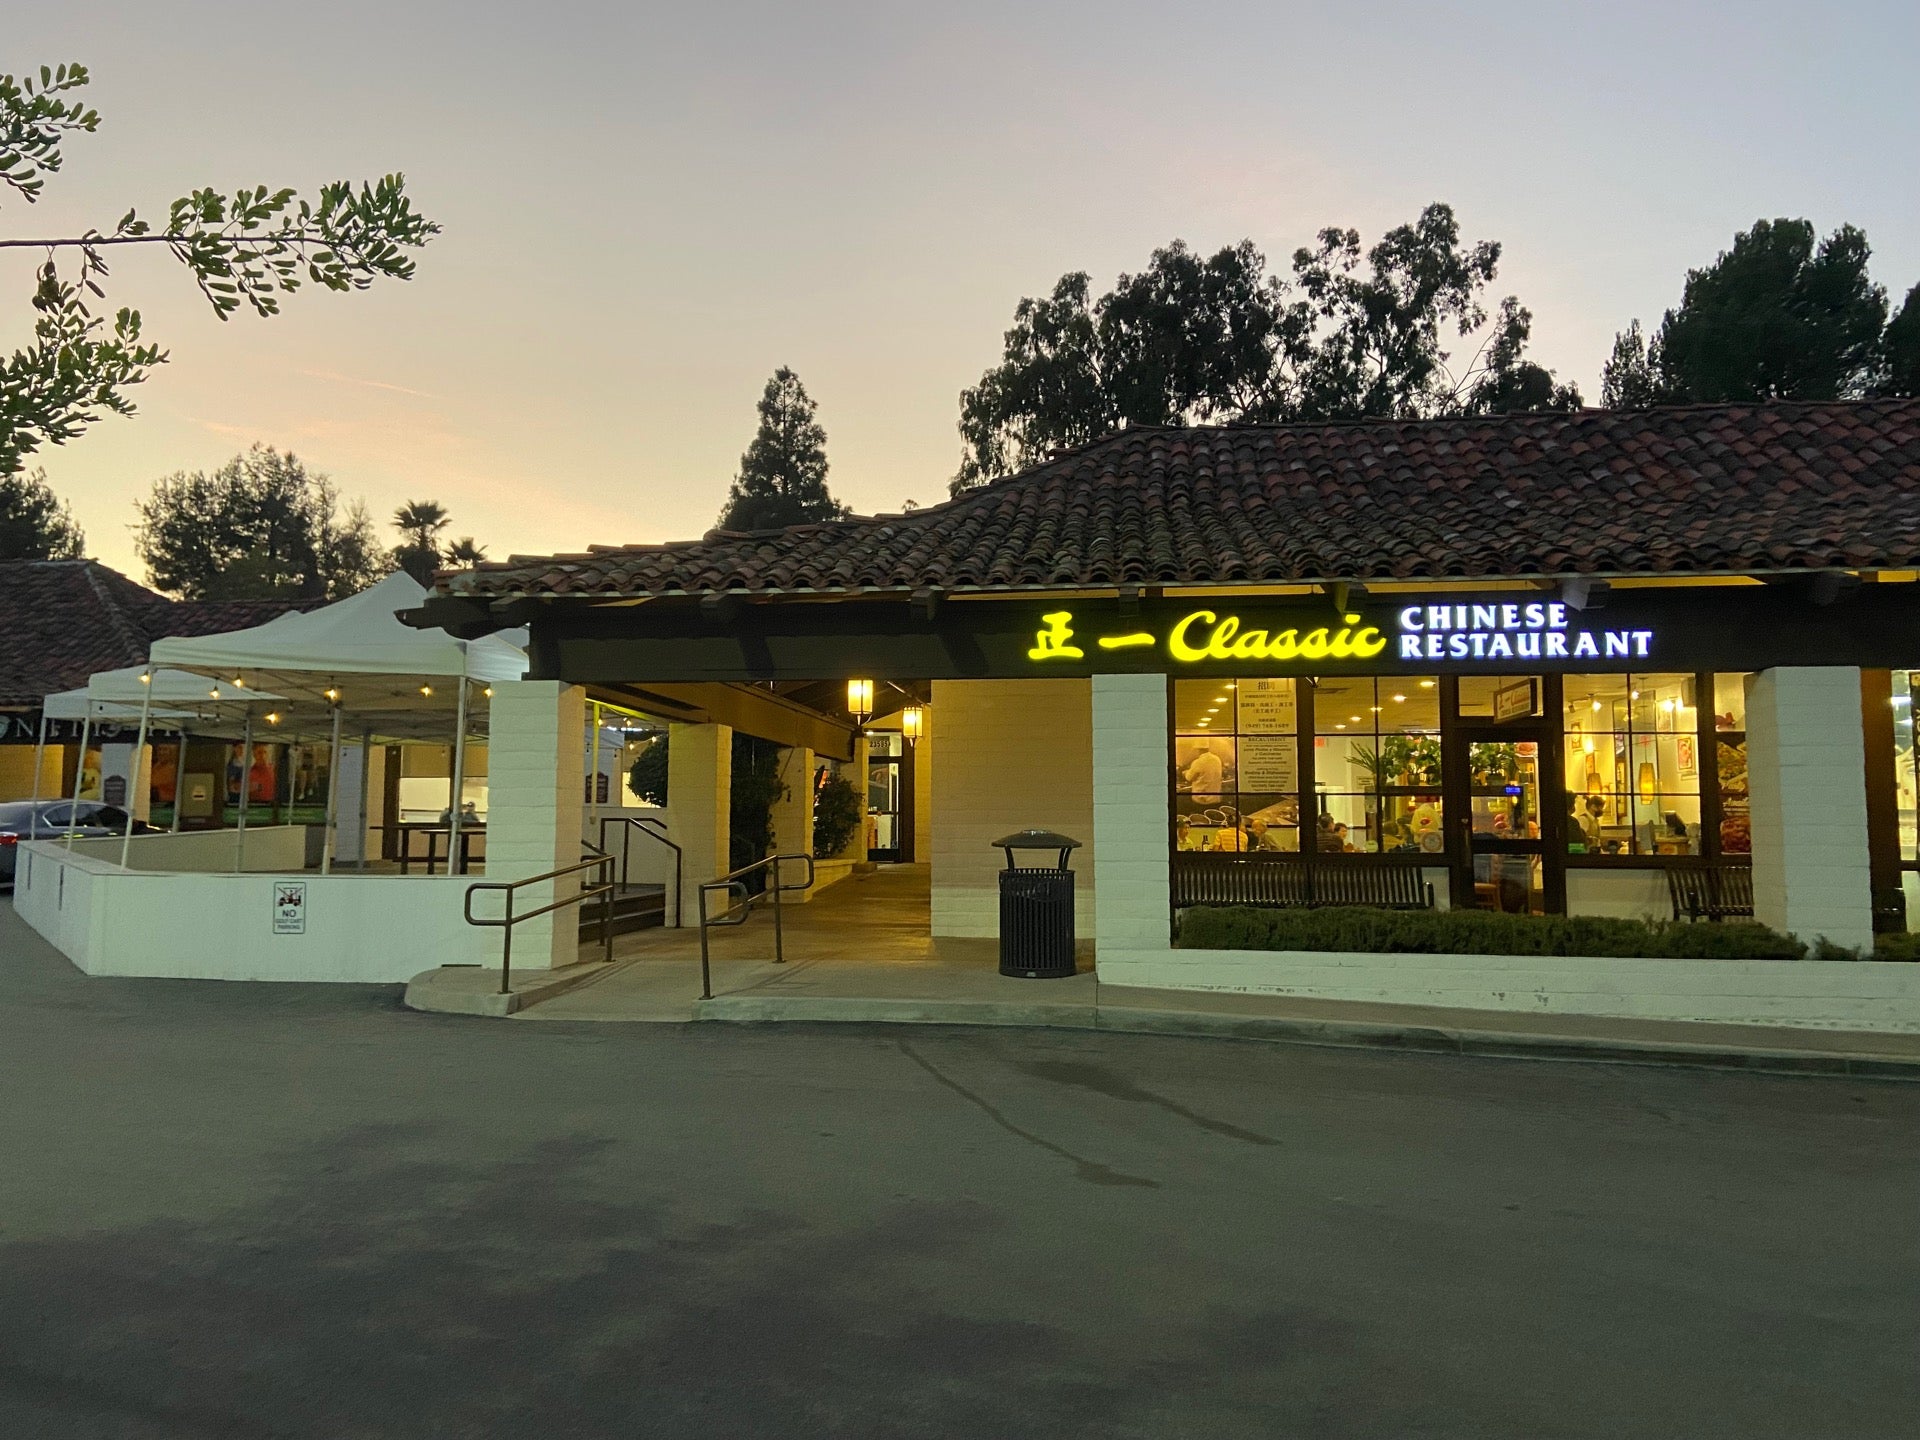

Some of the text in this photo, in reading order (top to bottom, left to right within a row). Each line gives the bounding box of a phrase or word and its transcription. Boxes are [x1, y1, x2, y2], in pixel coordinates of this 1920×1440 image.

[1400, 603, 1569, 631] CHINESE
[1169, 610, 1387, 661] Classic
[1400, 631, 1653, 659] RESTAURANT
[282, 909, 297, 917] NO
